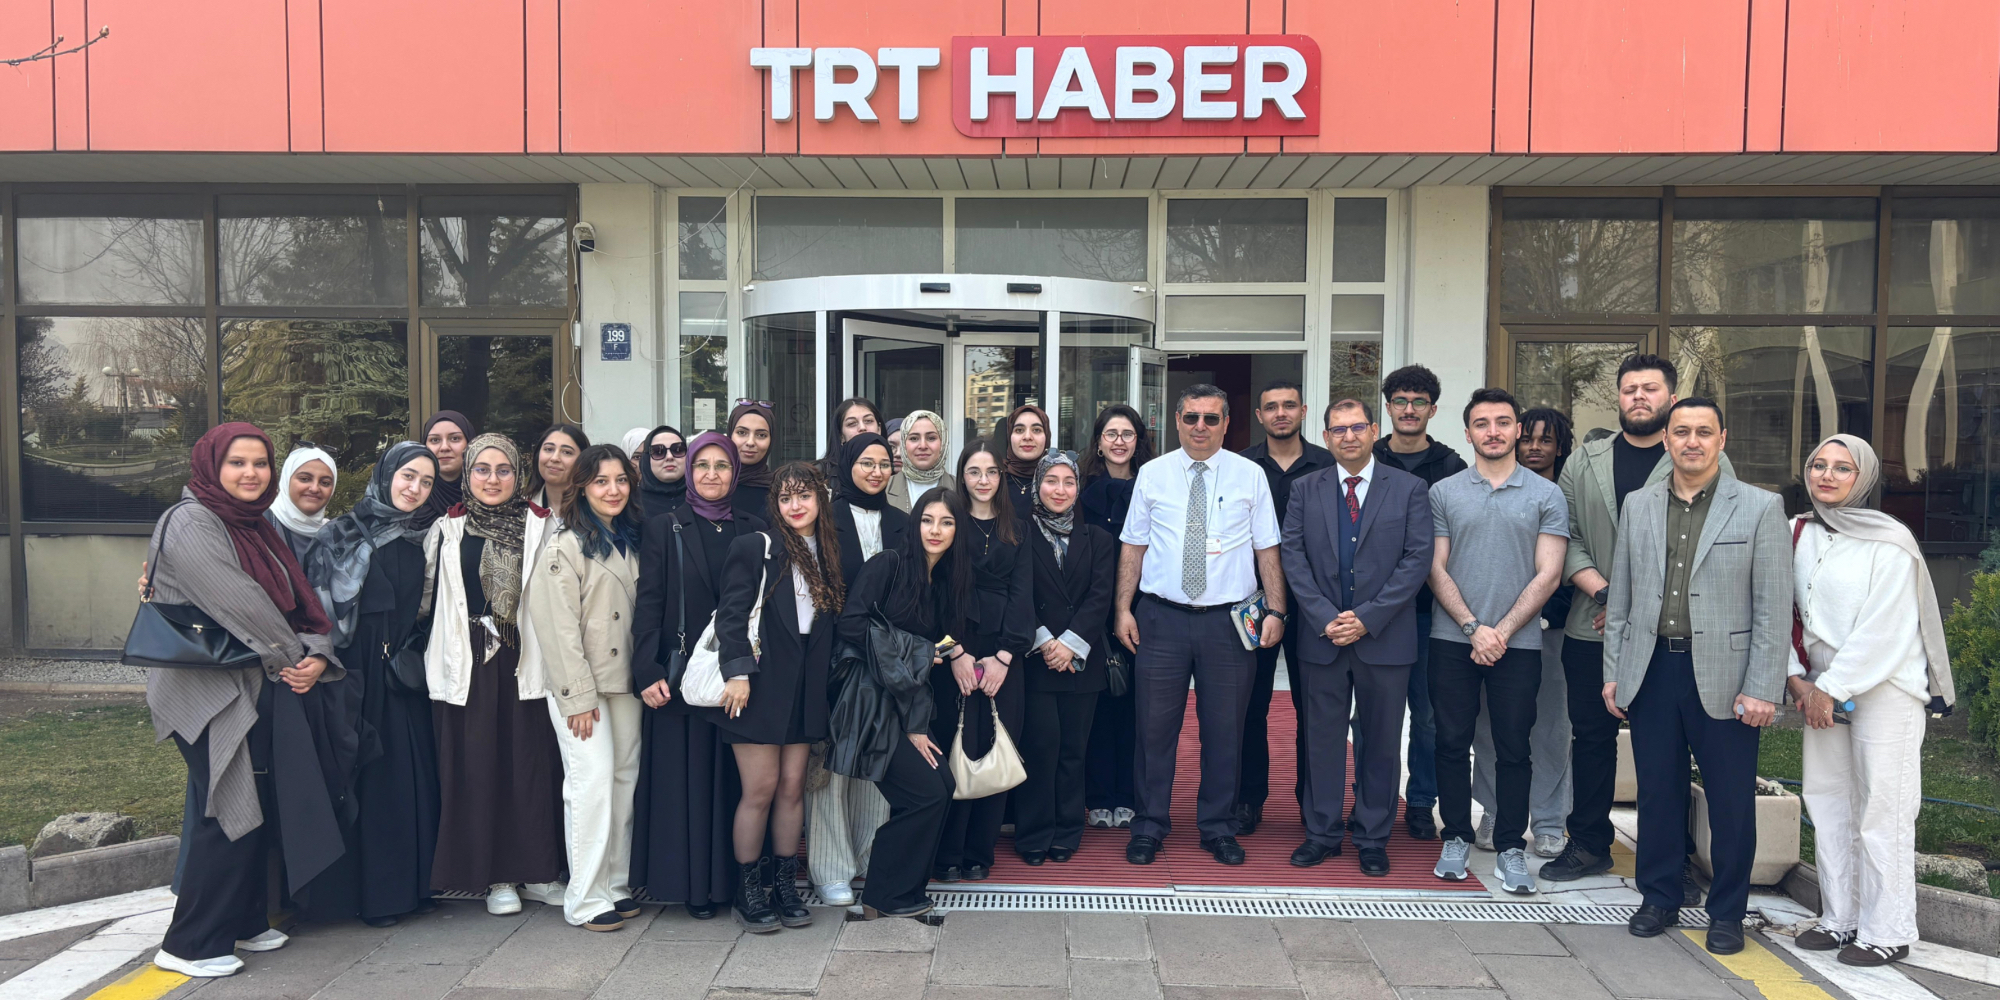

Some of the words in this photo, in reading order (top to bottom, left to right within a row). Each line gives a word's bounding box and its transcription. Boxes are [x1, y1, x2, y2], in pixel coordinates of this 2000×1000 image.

[750, 47, 941, 123] TRT
[969, 46, 1308, 122] HABER
[607, 330, 625, 342] 199
[613, 343, 618, 351] F
